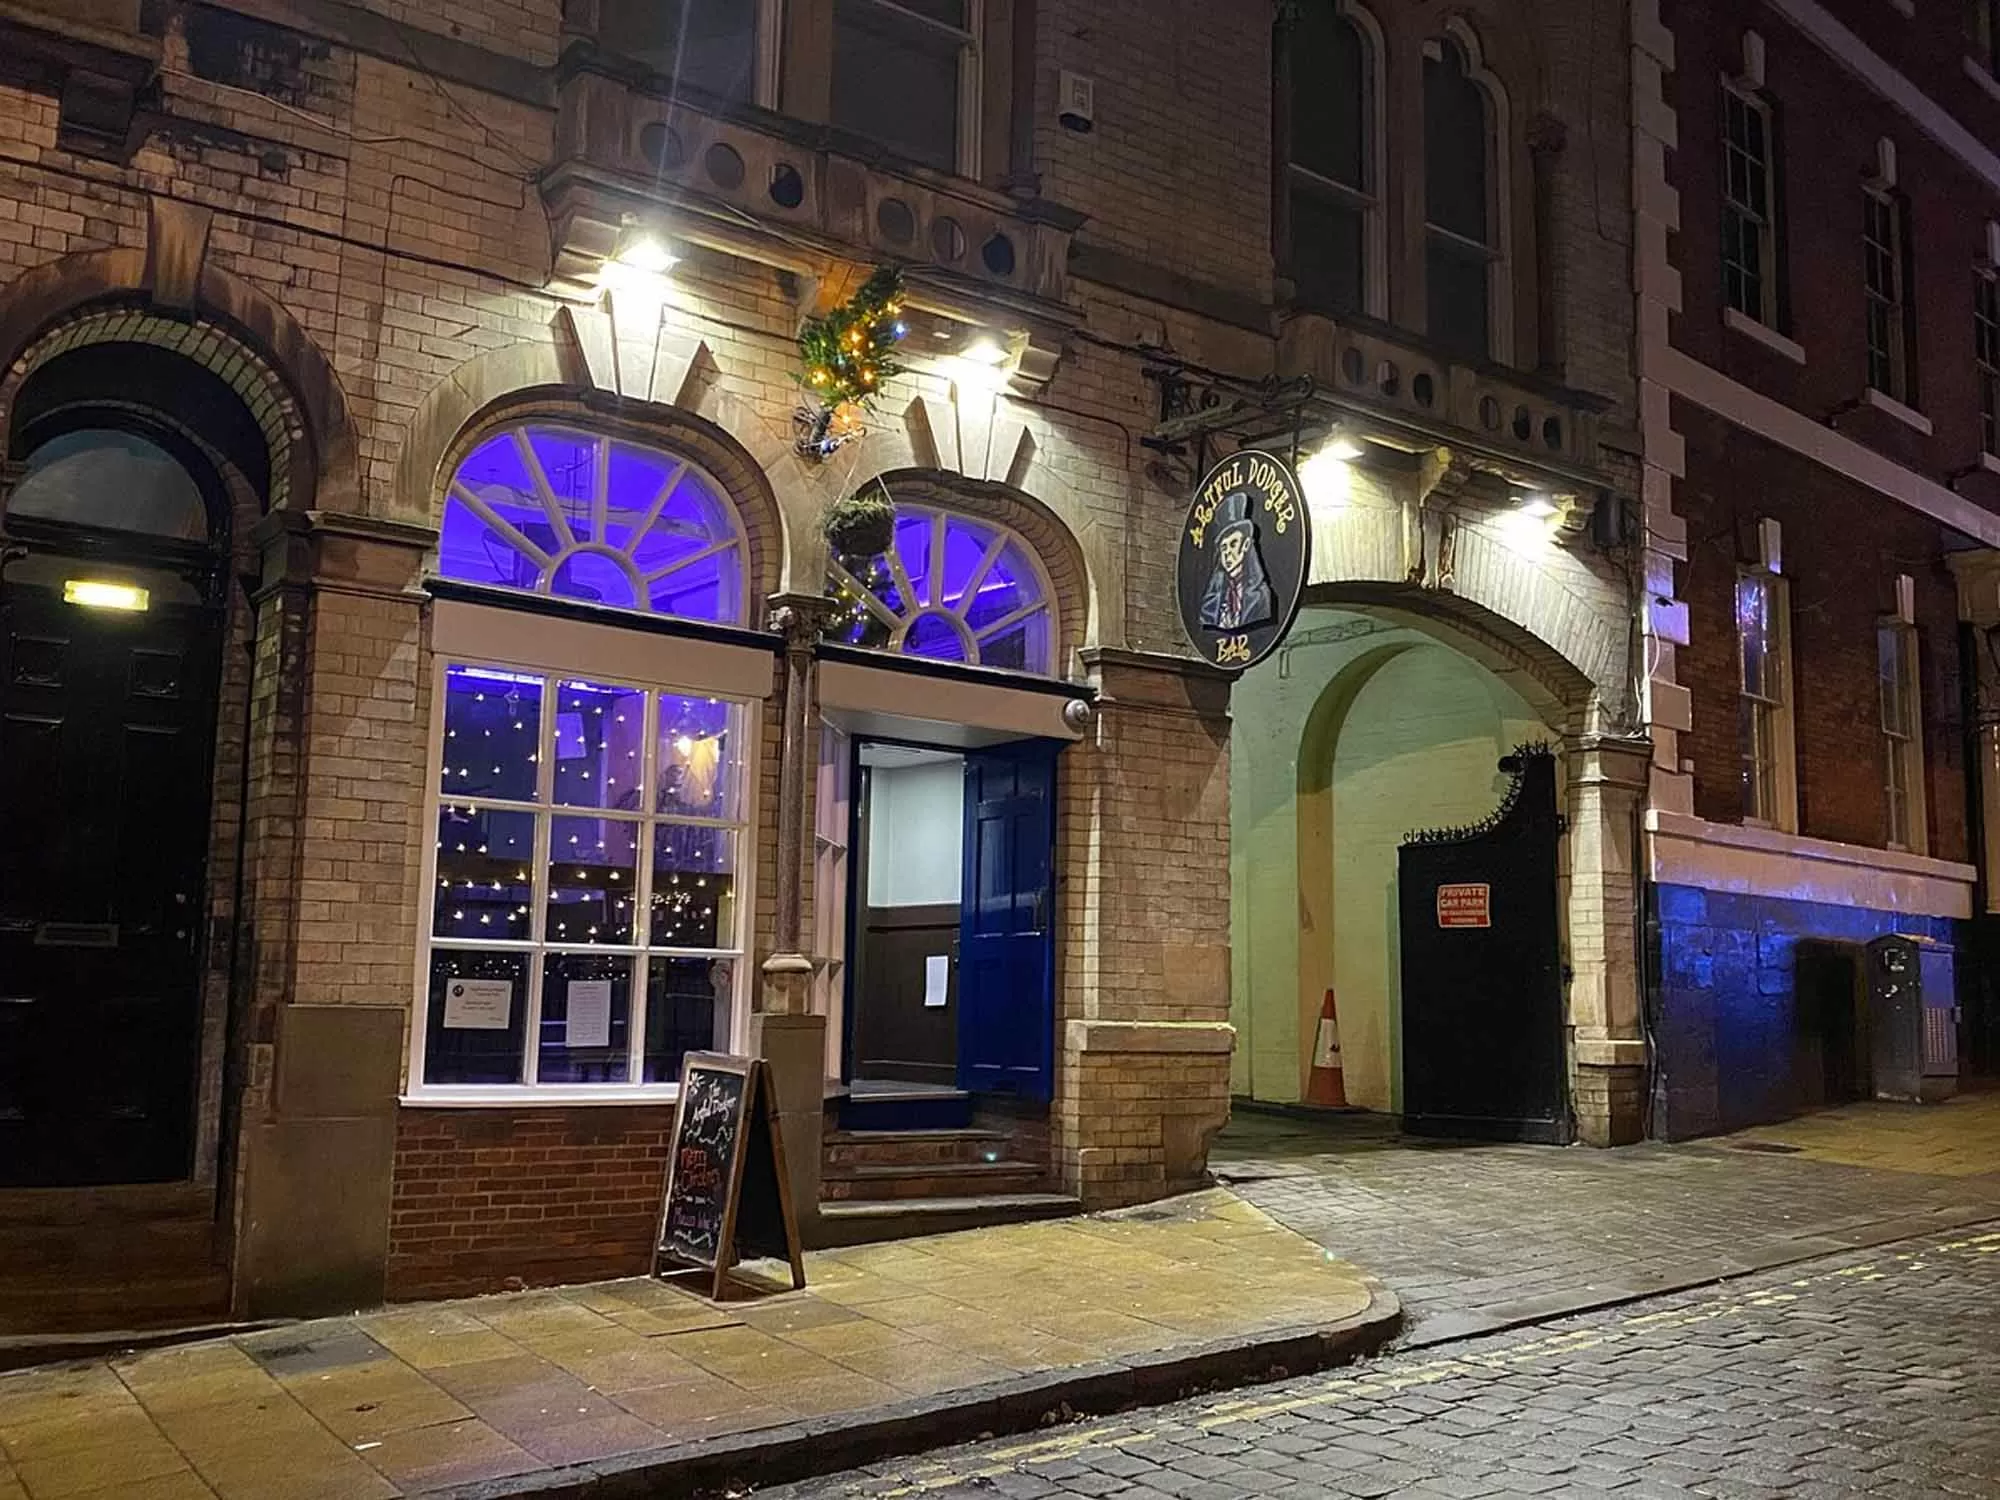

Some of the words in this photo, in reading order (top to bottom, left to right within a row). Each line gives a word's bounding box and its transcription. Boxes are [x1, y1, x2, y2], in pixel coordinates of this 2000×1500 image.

[1190, 461, 1243, 548] ARTFUL
[1247, 457, 1295, 533] DODGER
[1216, 634, 1250, 662] BAR
[1440, 887, 1485, 897] PRIVATE
[1440, 898, 1459, 909] CAR
[1460, 898, 1485, 908] PARK
